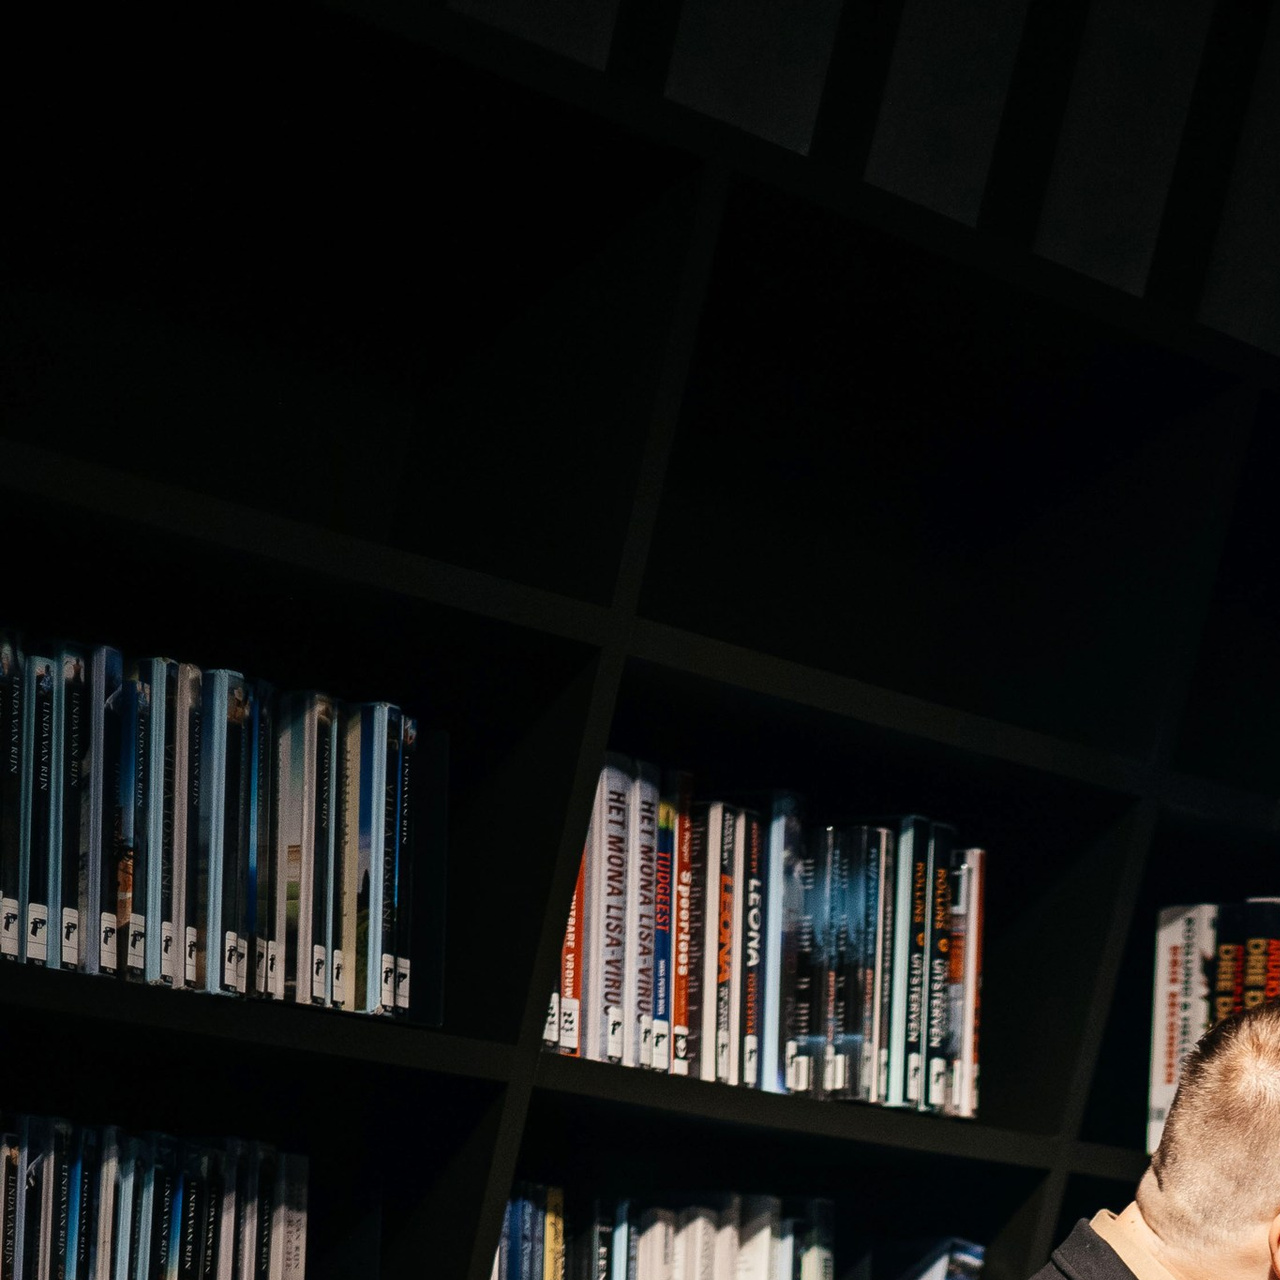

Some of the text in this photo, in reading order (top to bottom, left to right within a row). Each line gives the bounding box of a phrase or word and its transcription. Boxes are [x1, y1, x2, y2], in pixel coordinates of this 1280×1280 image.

[39, 701, 51, 791] LINDA VAN RIJN
[606, 789, 626, 896] HET MONA
[638, 799, 656, 906] HET MONA
[717, 873, 734, 983] LEONA
[746, 878, 761, 967] LEONA
